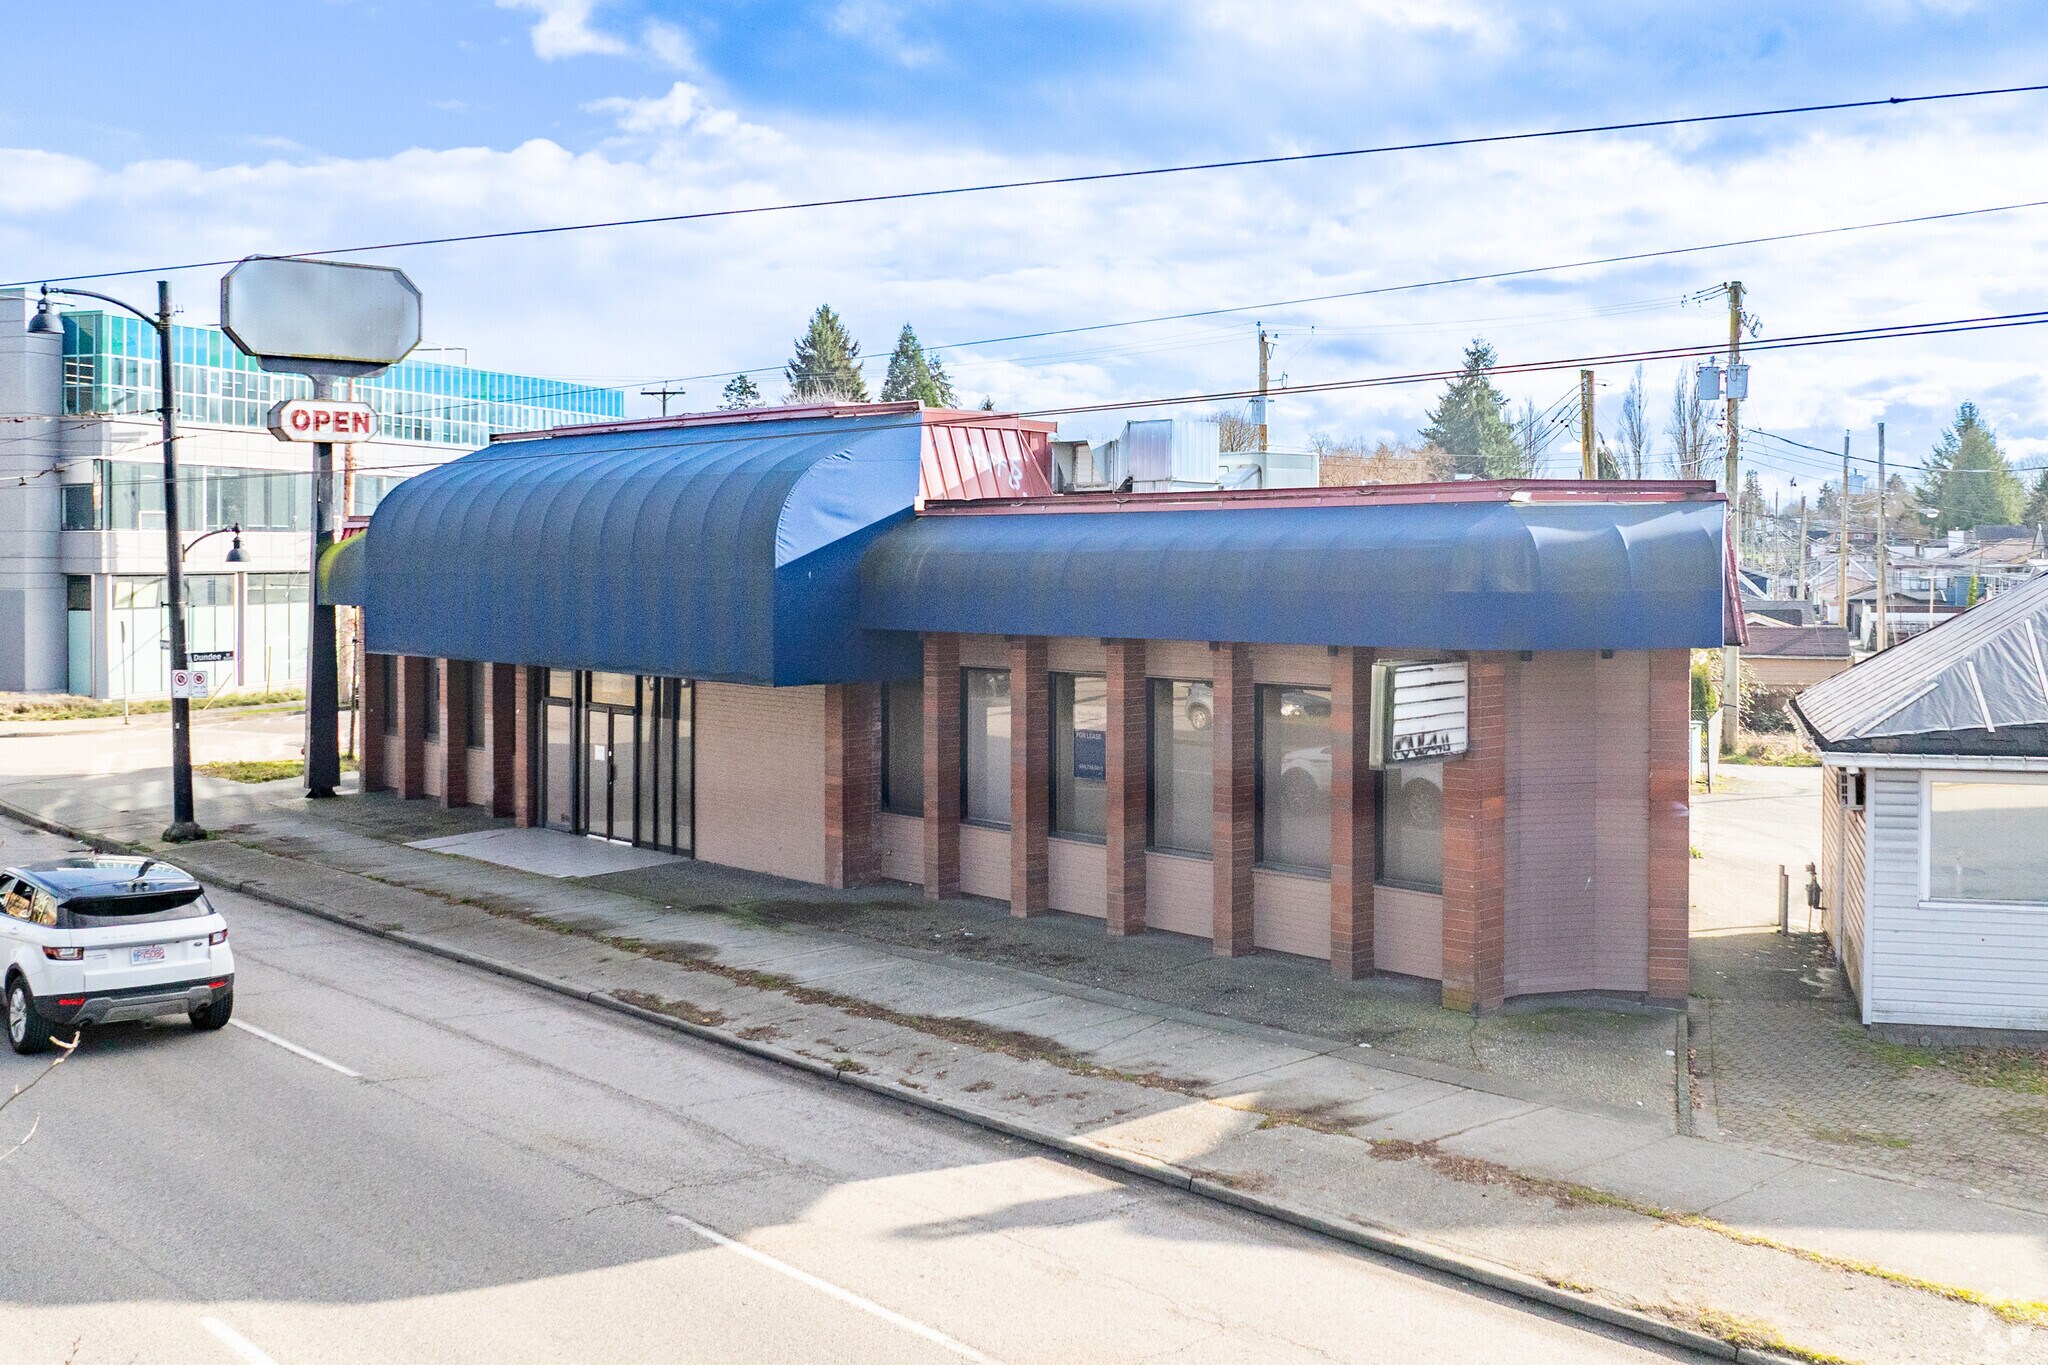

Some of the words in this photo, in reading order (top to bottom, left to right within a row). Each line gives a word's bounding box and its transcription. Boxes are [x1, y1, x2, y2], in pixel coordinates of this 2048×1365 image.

[290, 409, 370, 434] OPEN
[193, 653, 222, 662] Dundee
[1075, 731, 1086, 739] FOR
